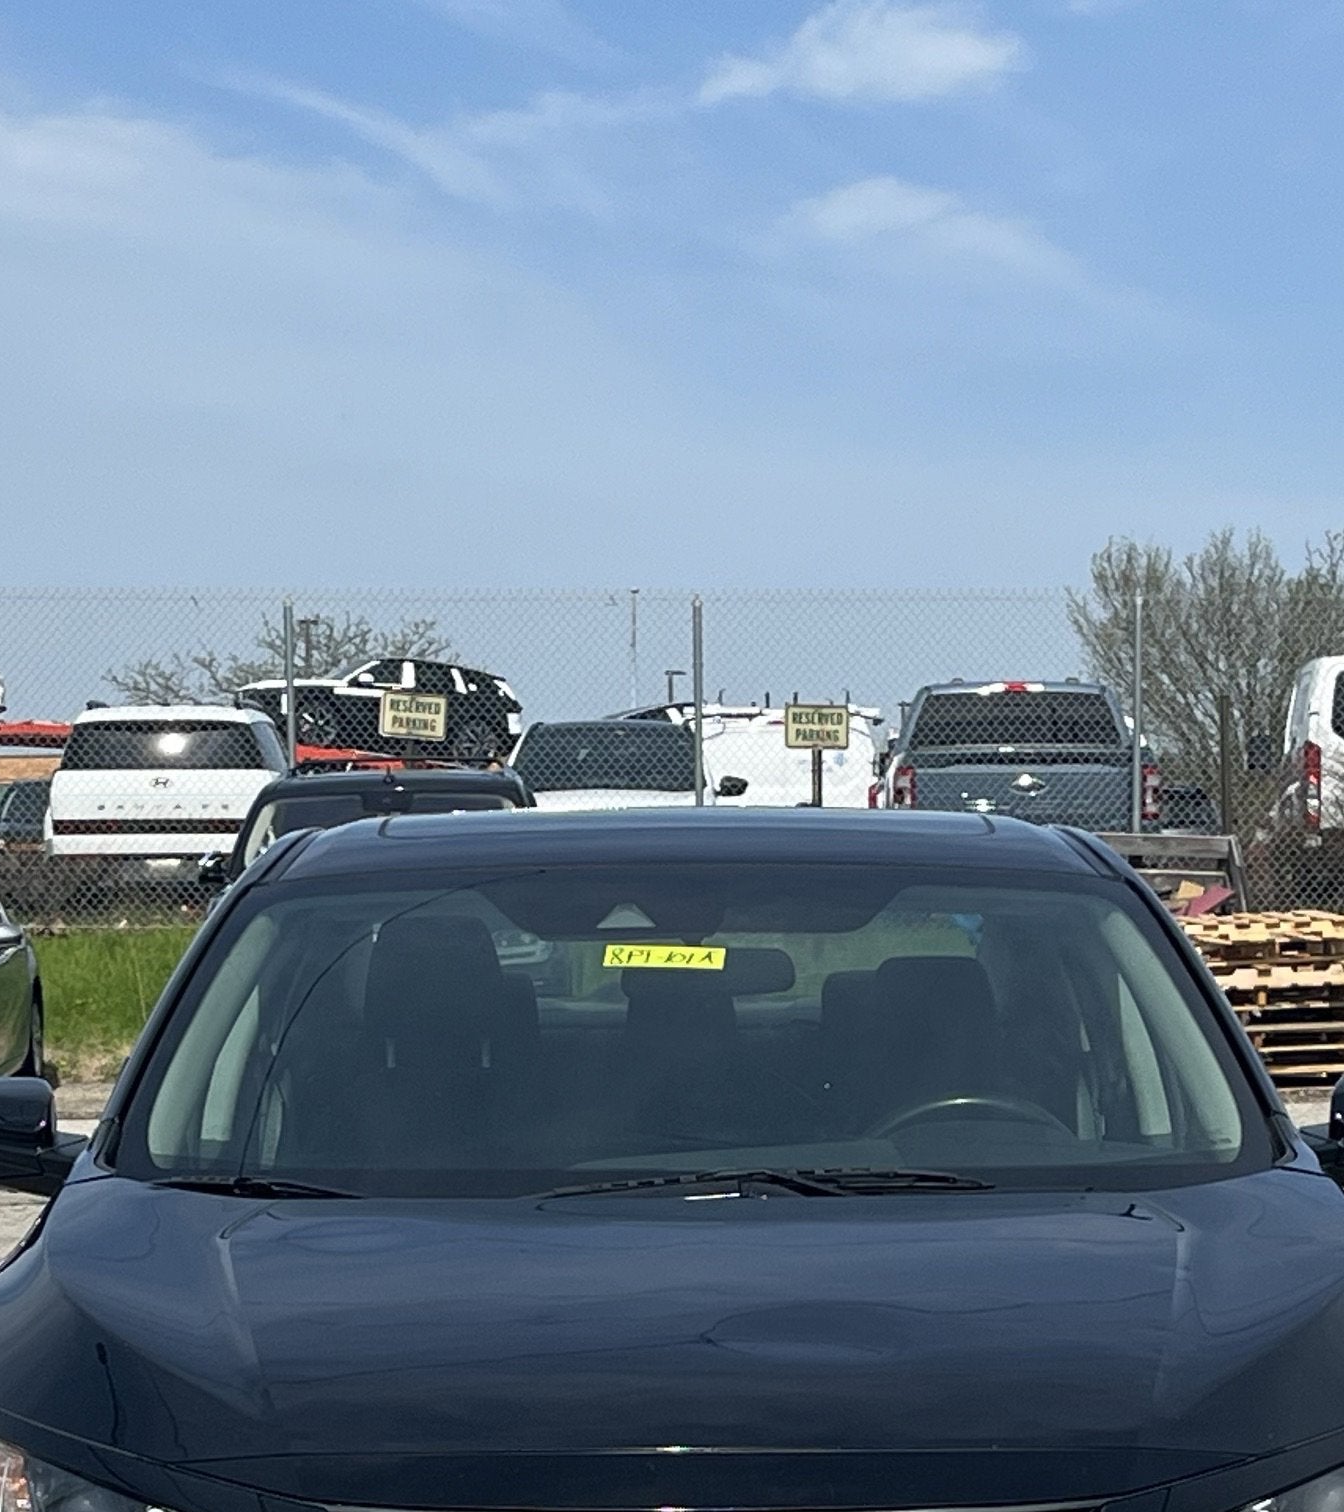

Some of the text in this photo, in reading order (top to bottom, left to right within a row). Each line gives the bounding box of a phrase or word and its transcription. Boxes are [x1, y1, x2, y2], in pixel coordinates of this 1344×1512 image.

[390, 699, 441, 715] RESERVED
[391, 715, 437, 732] PARKING
[792, 712, 843, 726] RESERVED
[795, 729, 840, 742] PARKING
